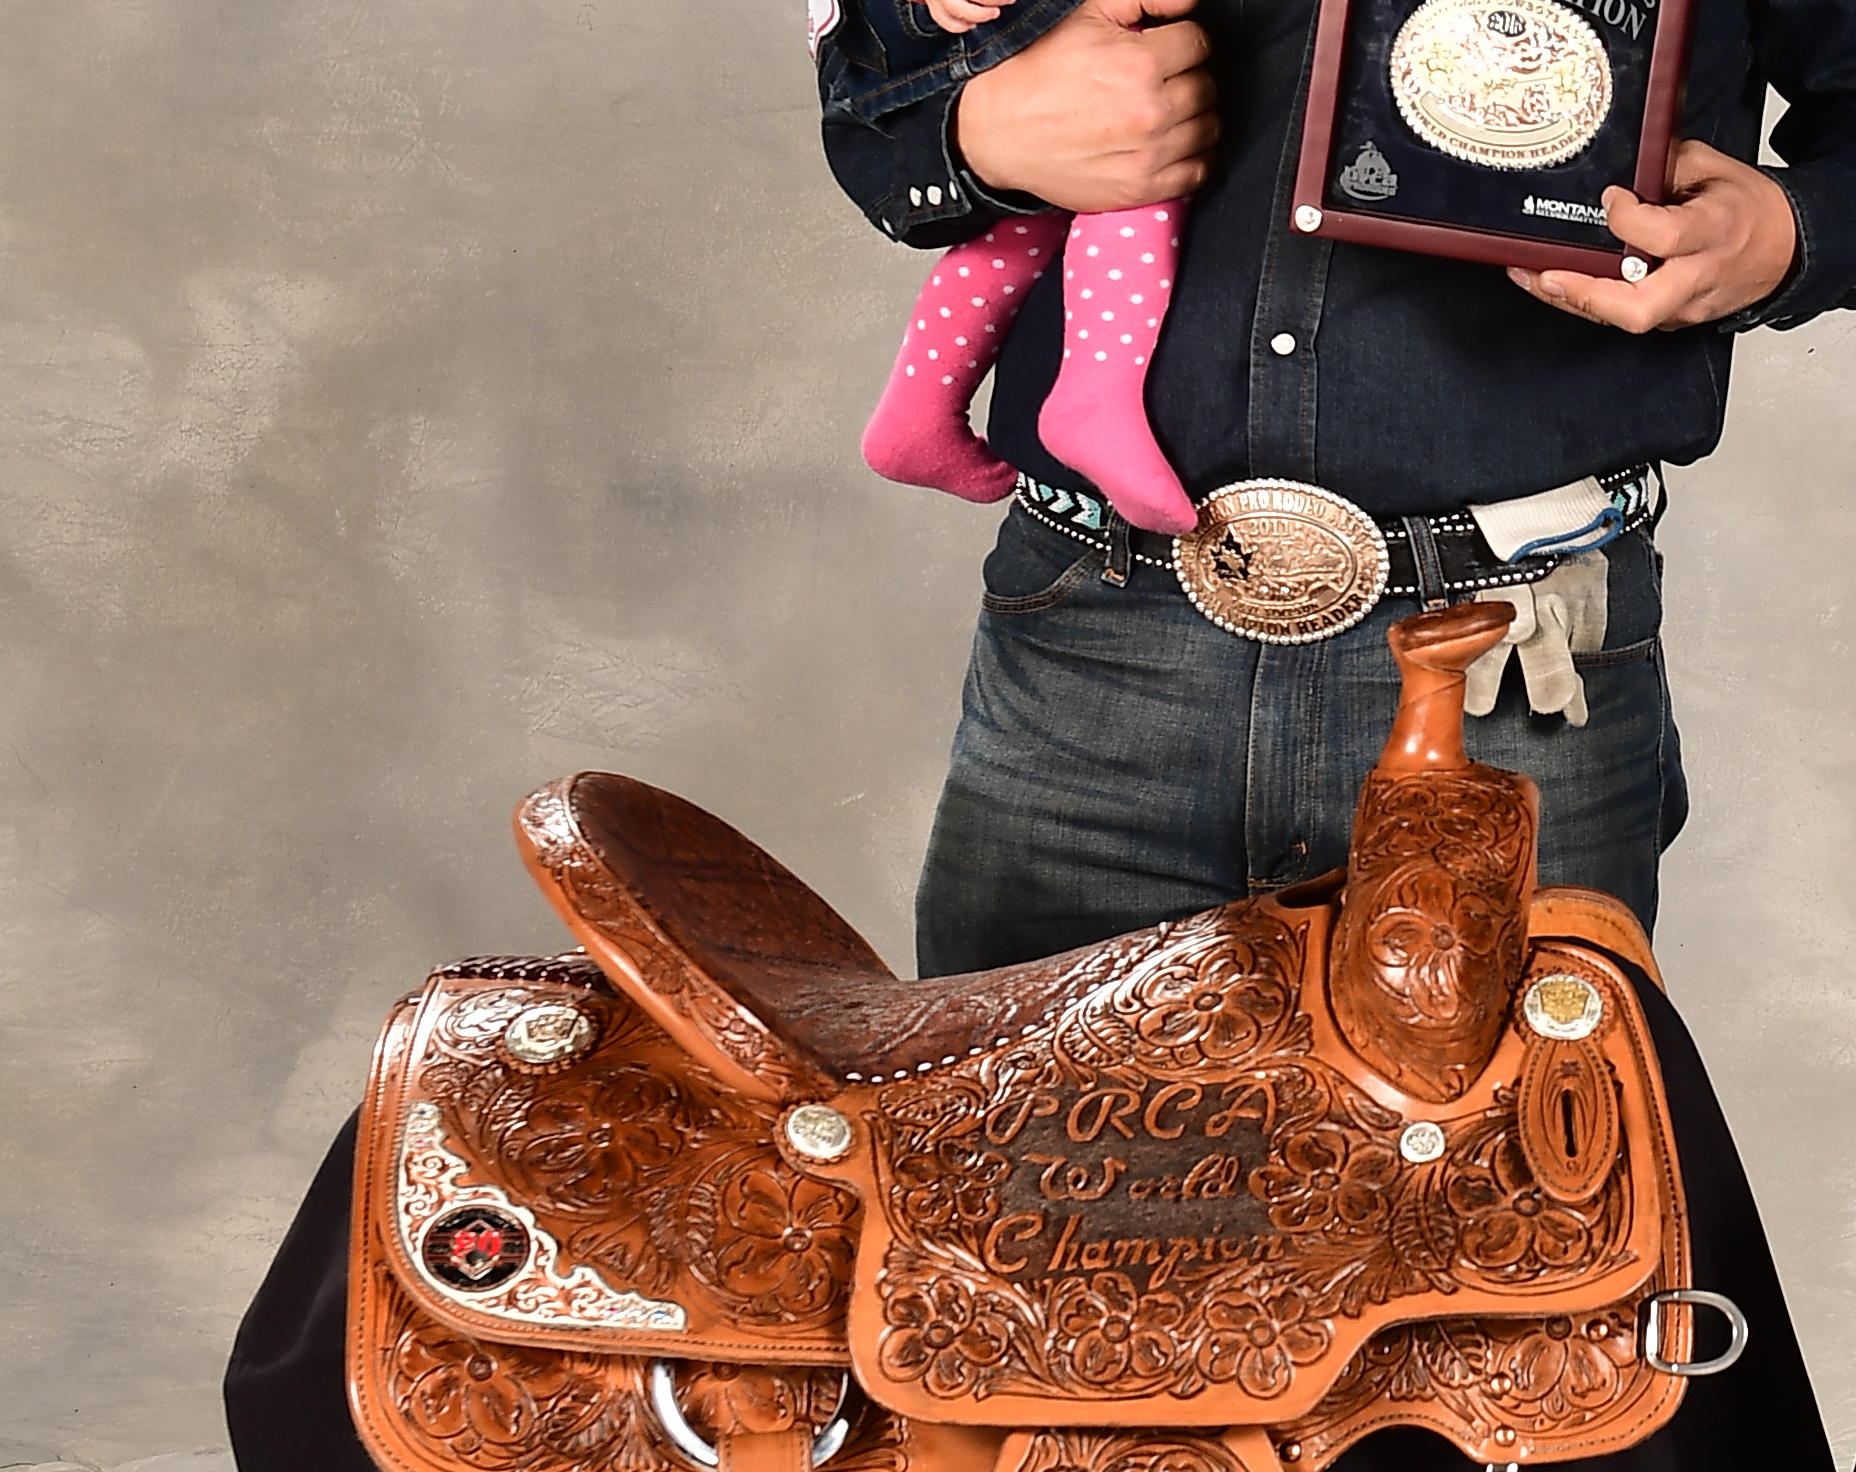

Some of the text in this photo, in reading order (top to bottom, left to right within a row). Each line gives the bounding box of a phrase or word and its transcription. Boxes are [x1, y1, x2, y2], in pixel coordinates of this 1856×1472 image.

[1449, 137, 1526, 159] CHAMPION
[1529, 128, 1584, 159] HEADER
[1536, 197, 1607, 221] MONTANA
[1240, 489, 1270, 511] PRO
[1272, 489, 1327, 516] RODEO
[1298, 592, 1370, 635] HEADER
[985, 1076, 1278, 1145] PRCA
[1021, 1153, 1242, 1201] World
[985, 1212, 1286, 1290] Champion
